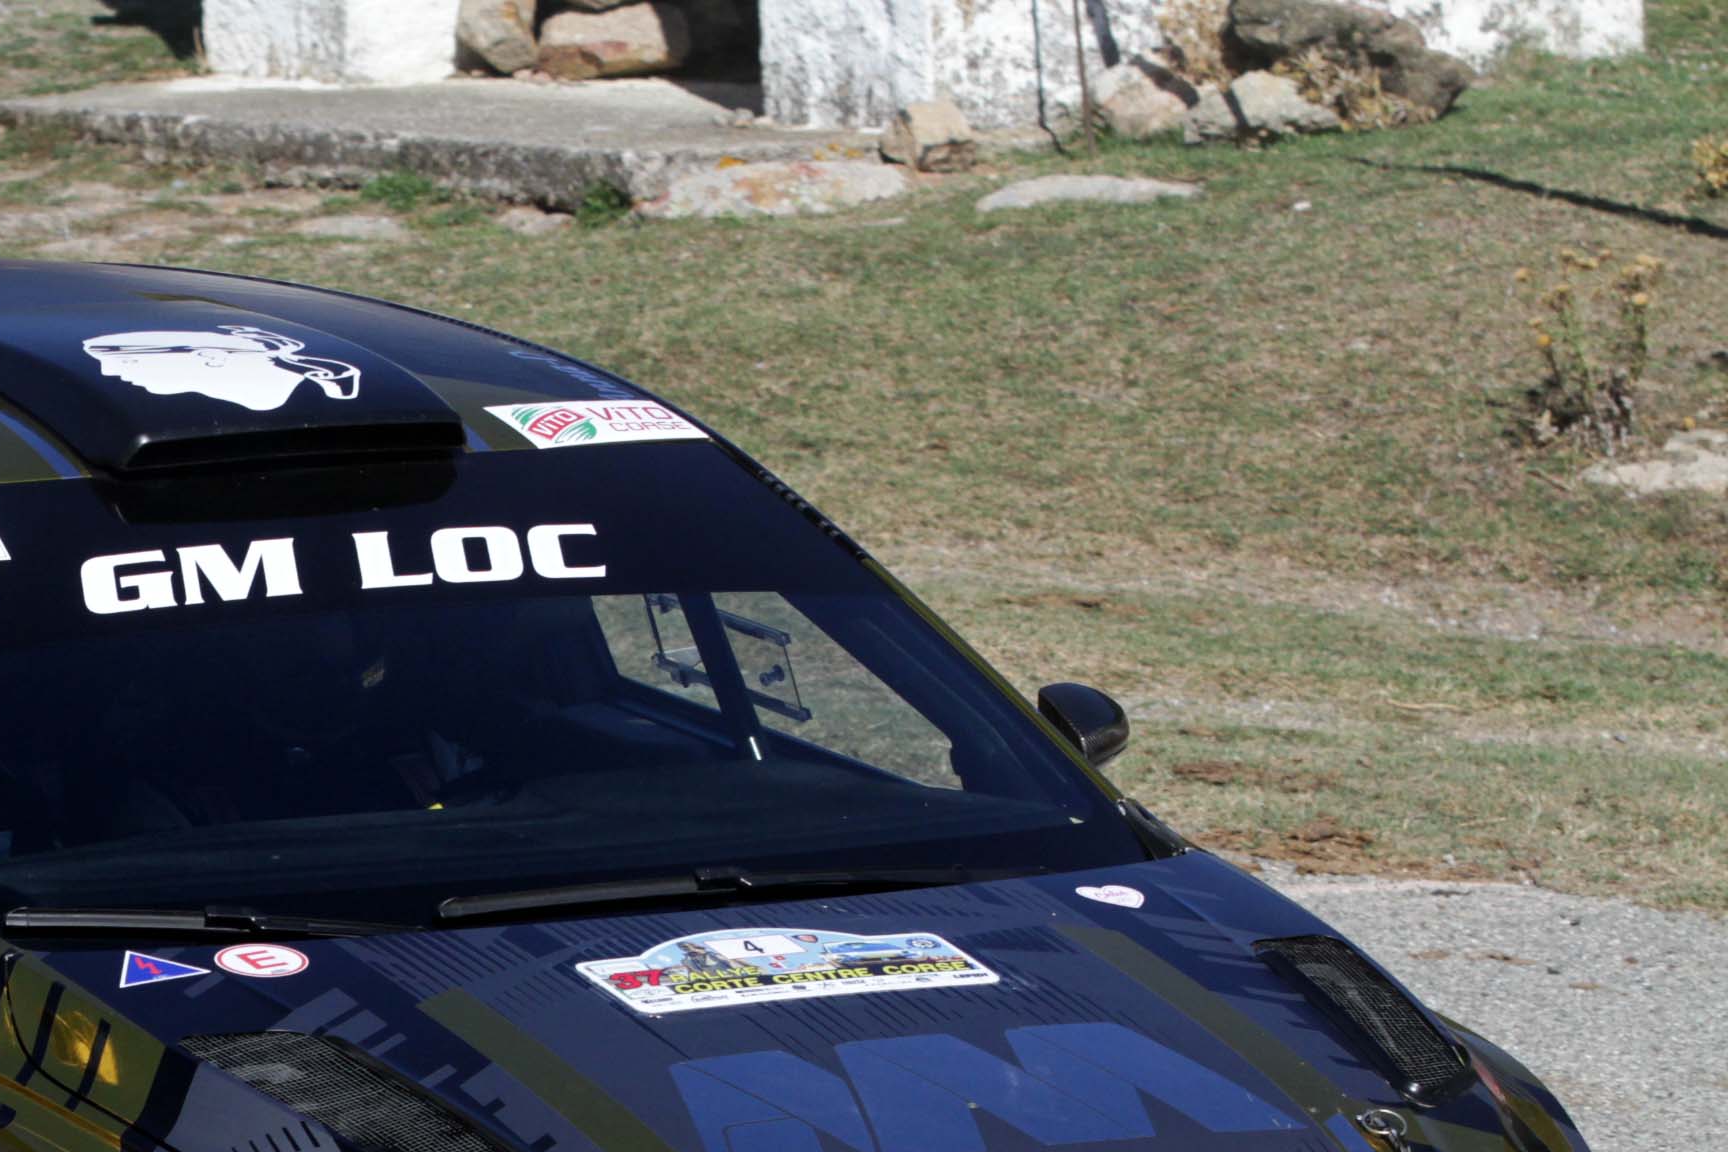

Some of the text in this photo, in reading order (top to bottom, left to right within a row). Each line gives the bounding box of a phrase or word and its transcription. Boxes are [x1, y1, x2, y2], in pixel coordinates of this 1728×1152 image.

[609, 421, 691, 431] CORSE
[80, 523, 606, 614] GM LOC
[744, 940, 765, 954] 4
[237, 950, 289, 970] E
[609, 966, 761, 990] 37 RALLYE
[675, 977, 763, 994] CORTE
[772, 967, 869, 985] CENTRE
[883, 961, 969, 975] CORSE
